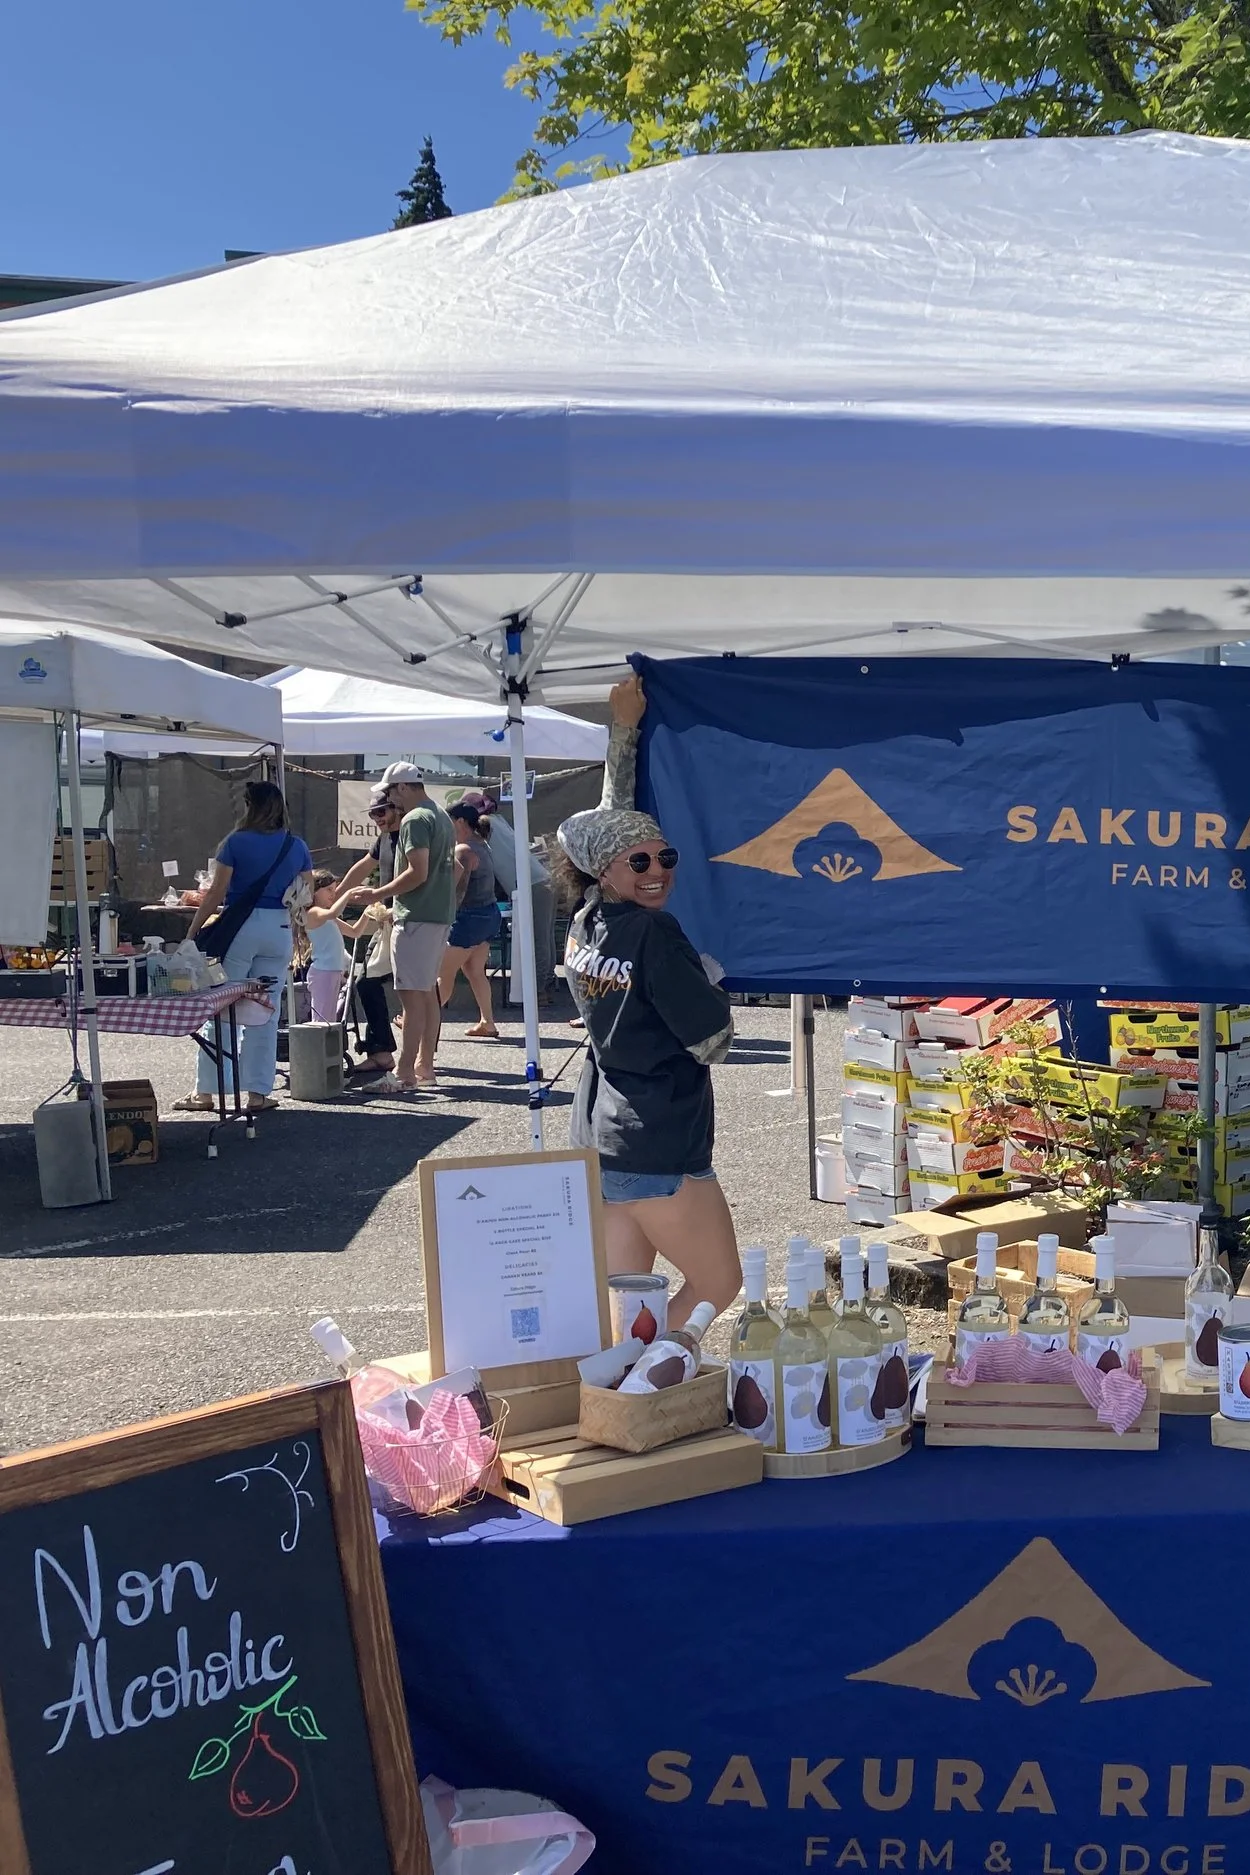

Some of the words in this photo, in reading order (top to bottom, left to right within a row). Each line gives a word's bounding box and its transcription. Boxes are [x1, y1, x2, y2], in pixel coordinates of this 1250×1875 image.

[1111, 863, 1210, 889] FARM
[1228, 866, 1248, 891] &
[1147, 1024, 1189, 1034] Northwest
[1156, 1034, 1180, 1043] Fruits
[34, 1524, 218, 1650] Non
[42, 1610, 294, 1755] Alcoholic
[645, 1750, 1058, 1816] SAKURA
[805, 1836, 956, 1871] FARM
[984, 1841, 1013, 1874] &
[1043, 1842, 1228, 1875] LODGE
